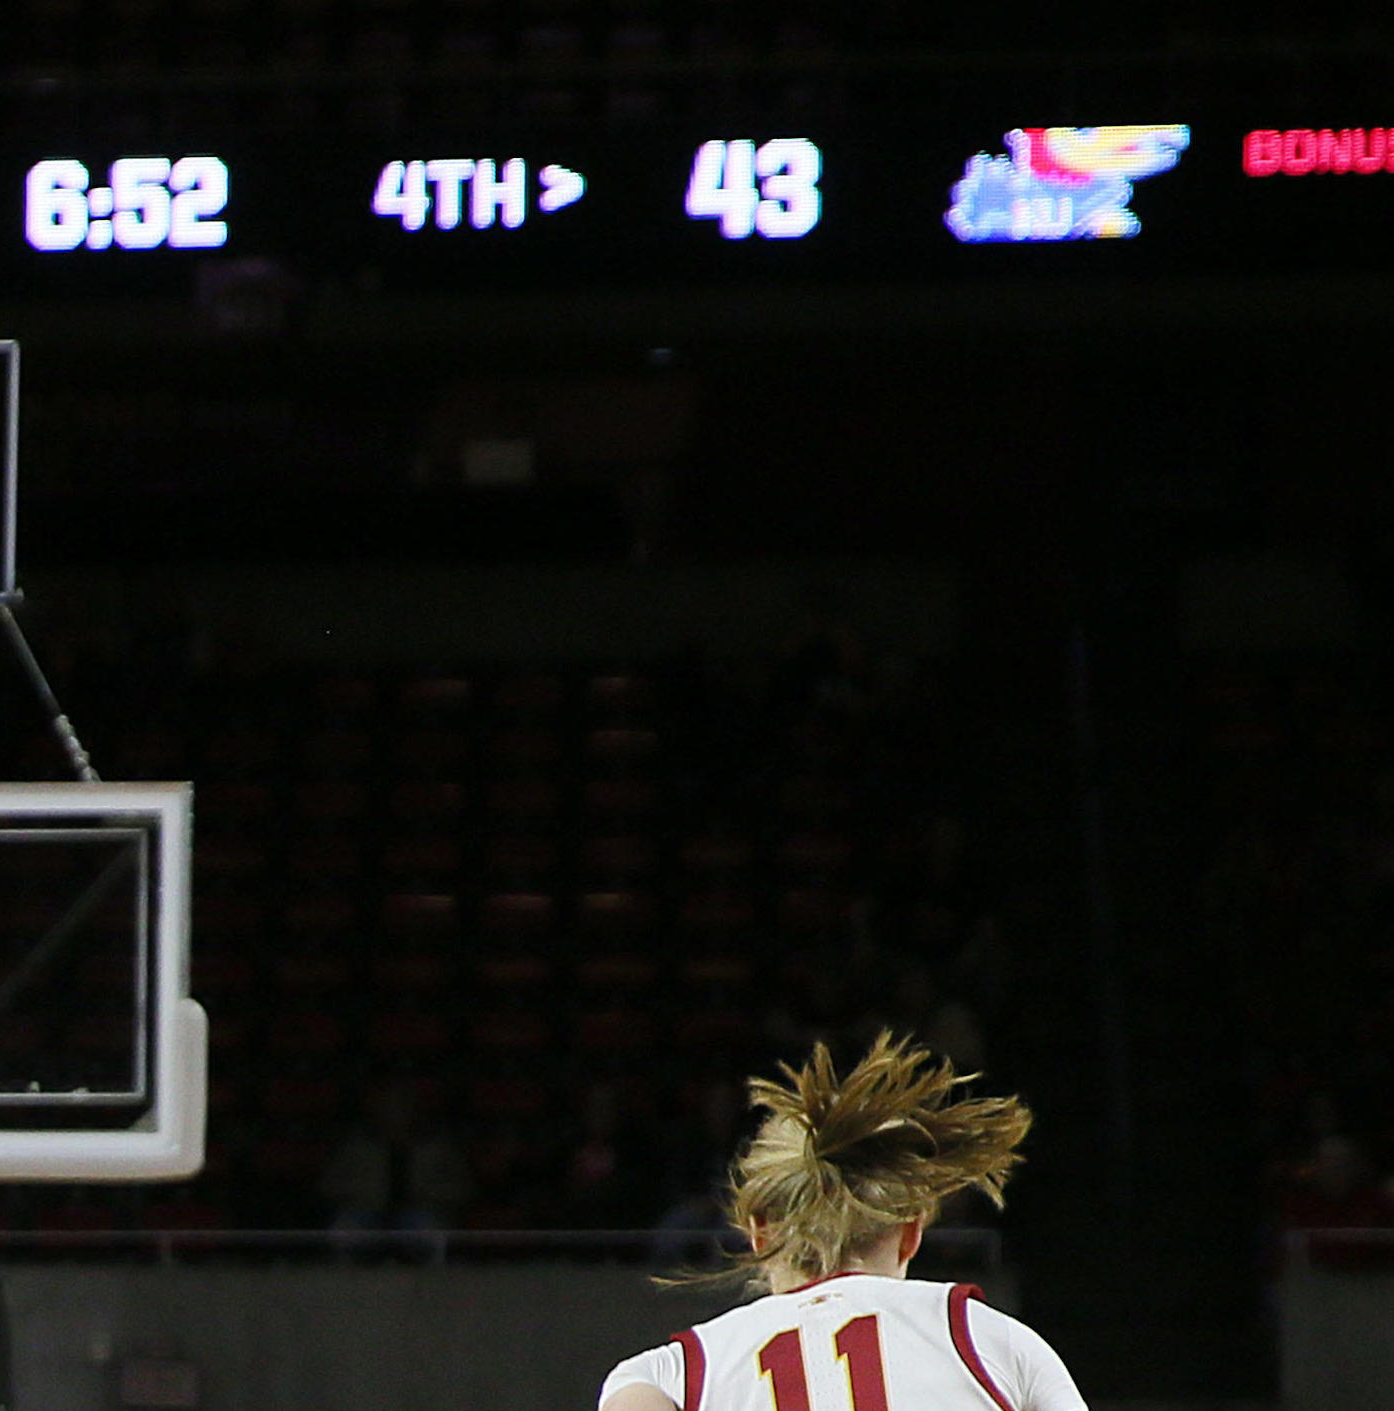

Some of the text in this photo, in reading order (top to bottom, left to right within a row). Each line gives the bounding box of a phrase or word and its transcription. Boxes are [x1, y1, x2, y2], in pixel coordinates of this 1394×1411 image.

[684, 137, 823, 241] 43
[1242, 128, 1394, 178] BONU
[24, 156, 229, 252] 6:52
